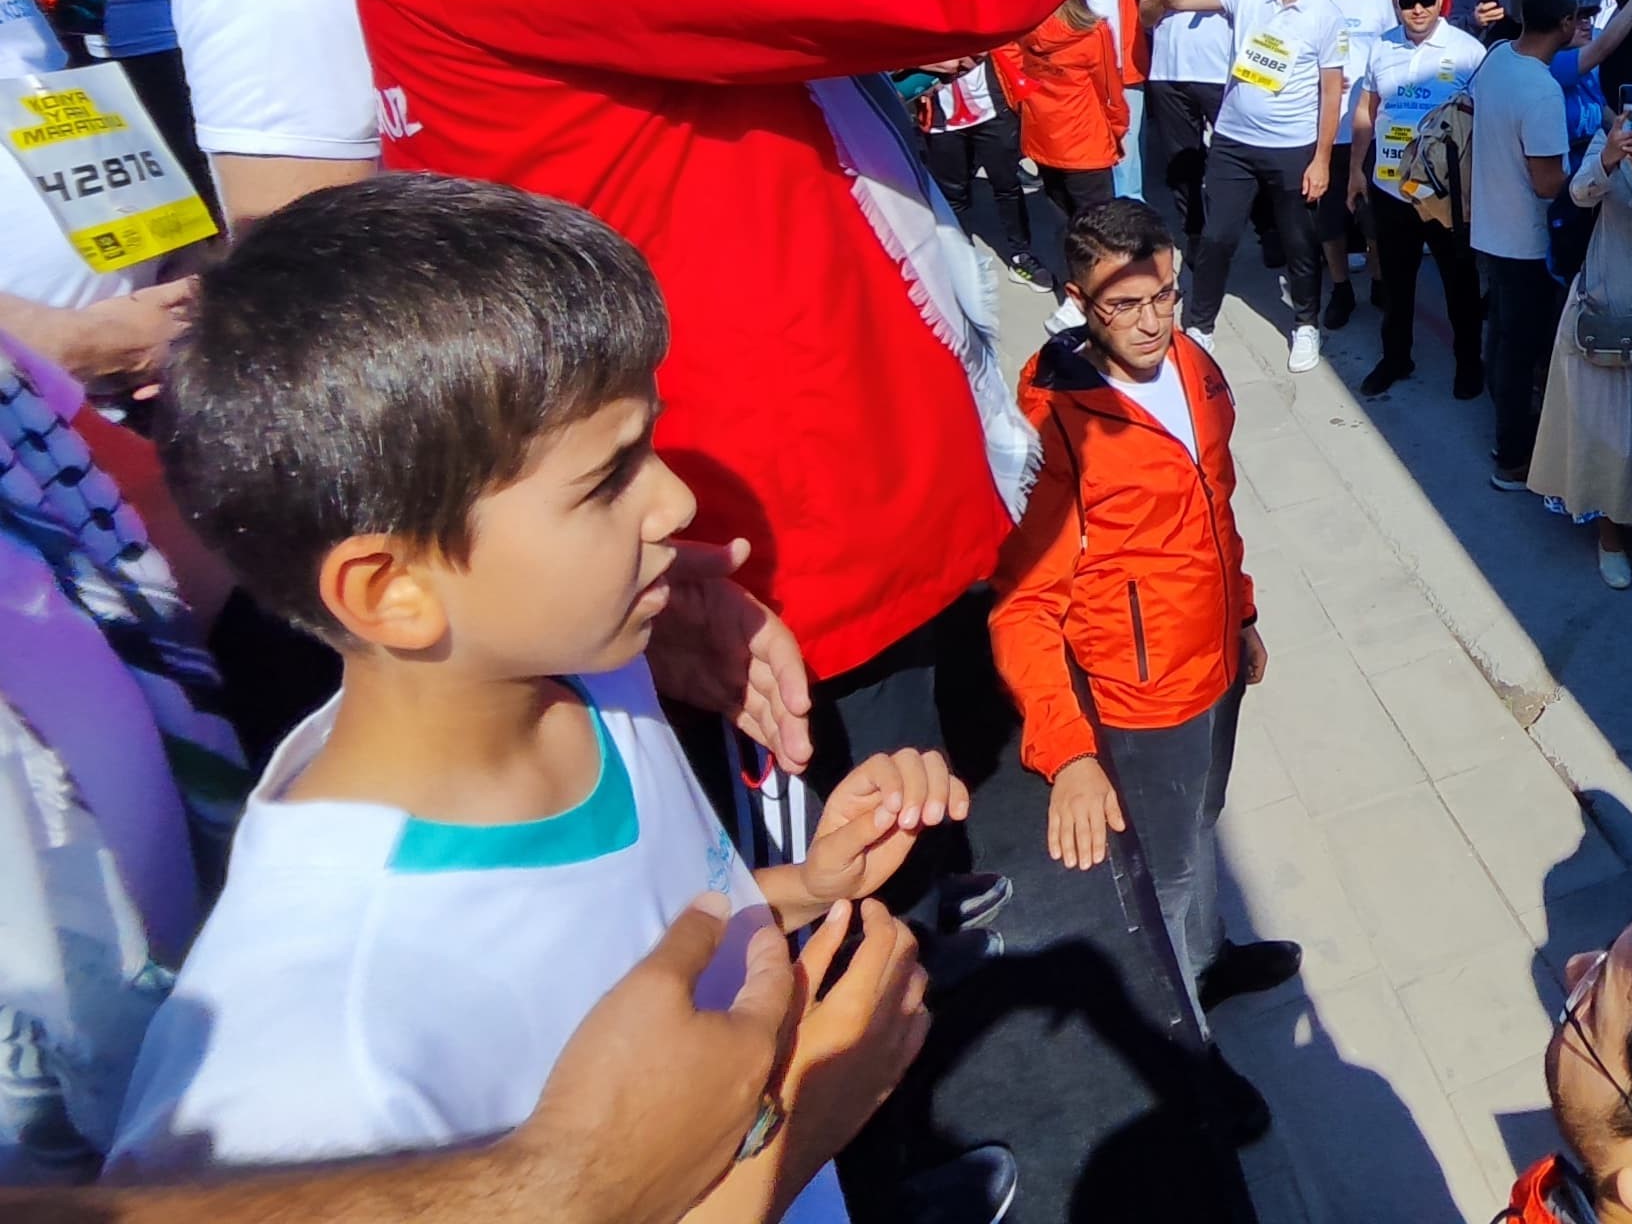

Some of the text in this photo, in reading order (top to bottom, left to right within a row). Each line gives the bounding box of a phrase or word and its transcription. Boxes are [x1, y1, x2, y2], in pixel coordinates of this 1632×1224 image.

[1245, 49, 1288, 73] 42882
[23, 115, 124, 145] MARATONU
[36, 150, 165, 203] 42876
